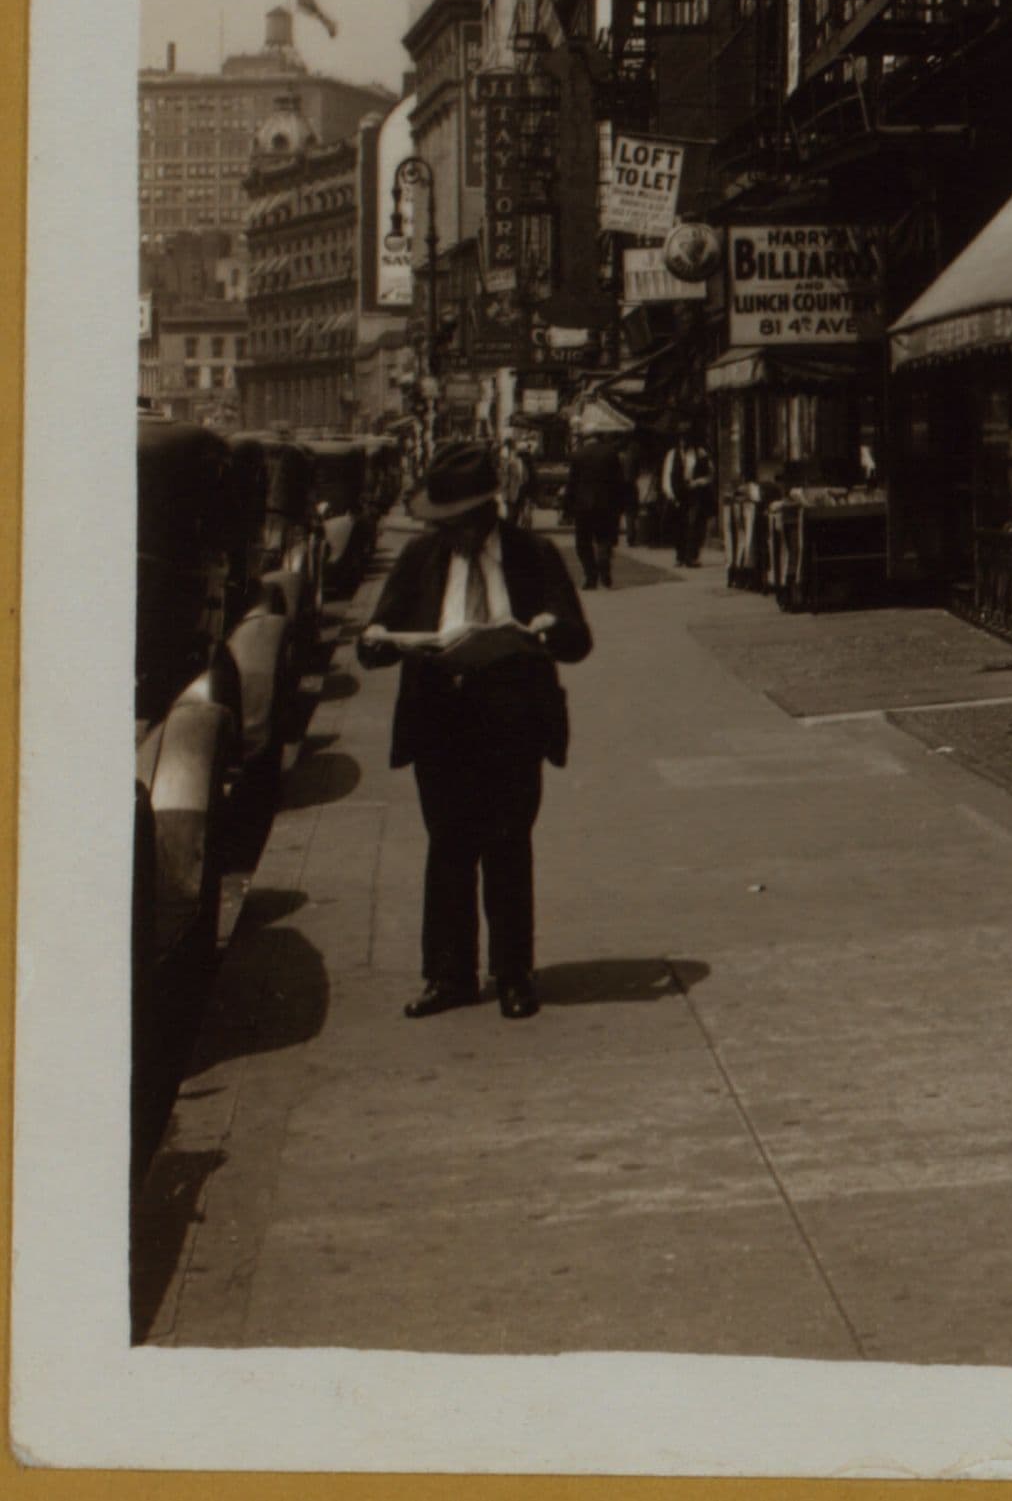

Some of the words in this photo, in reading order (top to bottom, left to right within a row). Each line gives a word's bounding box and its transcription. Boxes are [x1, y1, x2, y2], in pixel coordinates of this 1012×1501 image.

[620, 143, 680, 170] LOFT
[616, 167, 638, 186] TO
[642, 170, 677, 192] LET
[795, 282, 824, 291] AND
[735, 293, 789, 314] LUNCH
